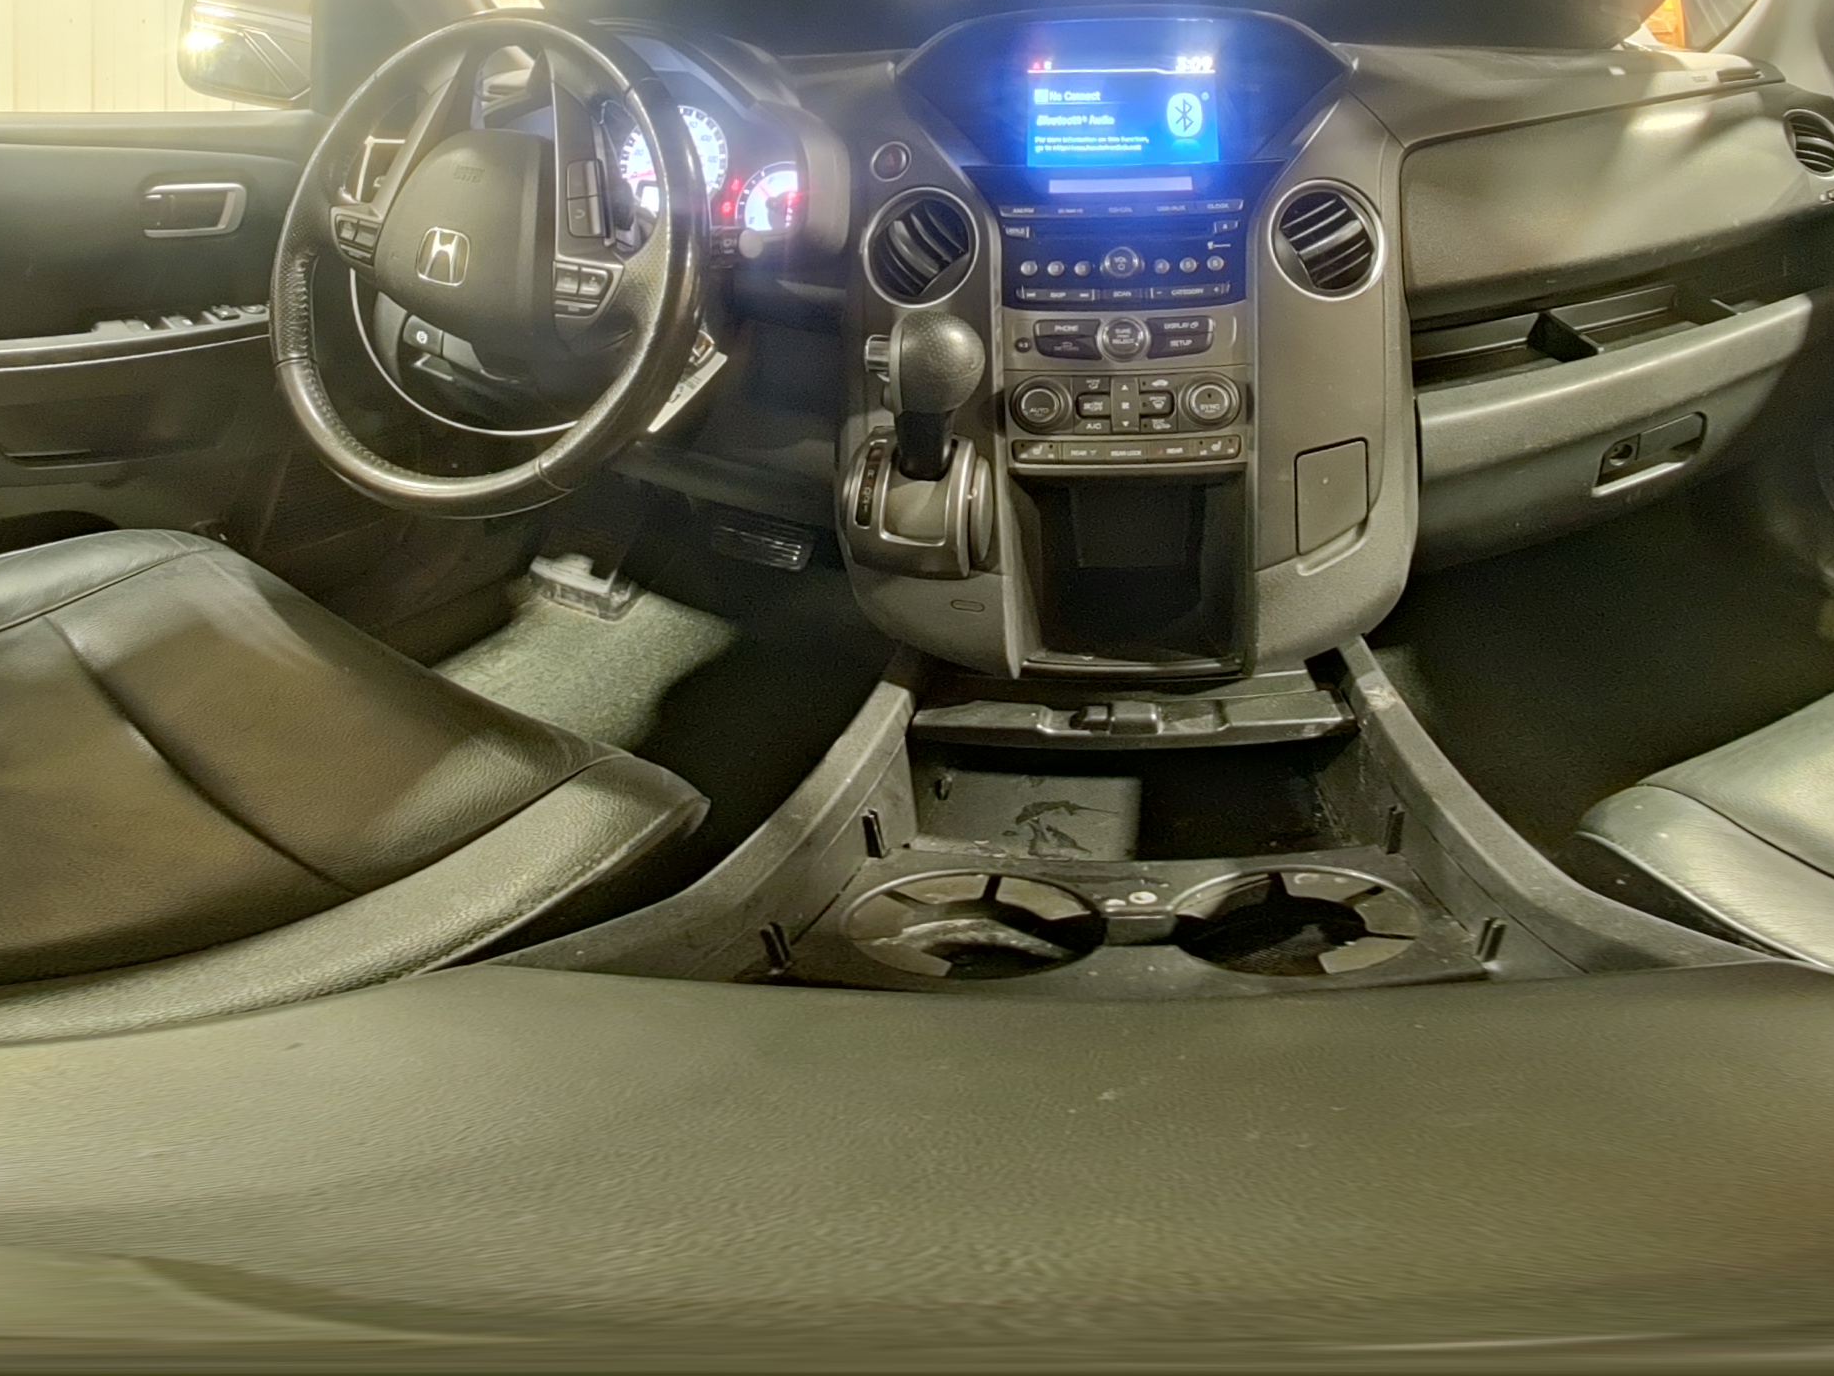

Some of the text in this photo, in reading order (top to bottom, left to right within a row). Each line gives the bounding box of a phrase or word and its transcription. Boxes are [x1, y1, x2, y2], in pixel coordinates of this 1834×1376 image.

[1049, 91, 1101, 102] No Connect
[1089, 115, 1115, 126] Audio
[1171, 287, 1205, 296] CATEGORY
[1164, 322, 1189, 330] DISPLAY
[1169, 339, 1193, 347] SETUP
[1086, 422, 1102, 430] A/C
[868, 469, 875, 478] R
